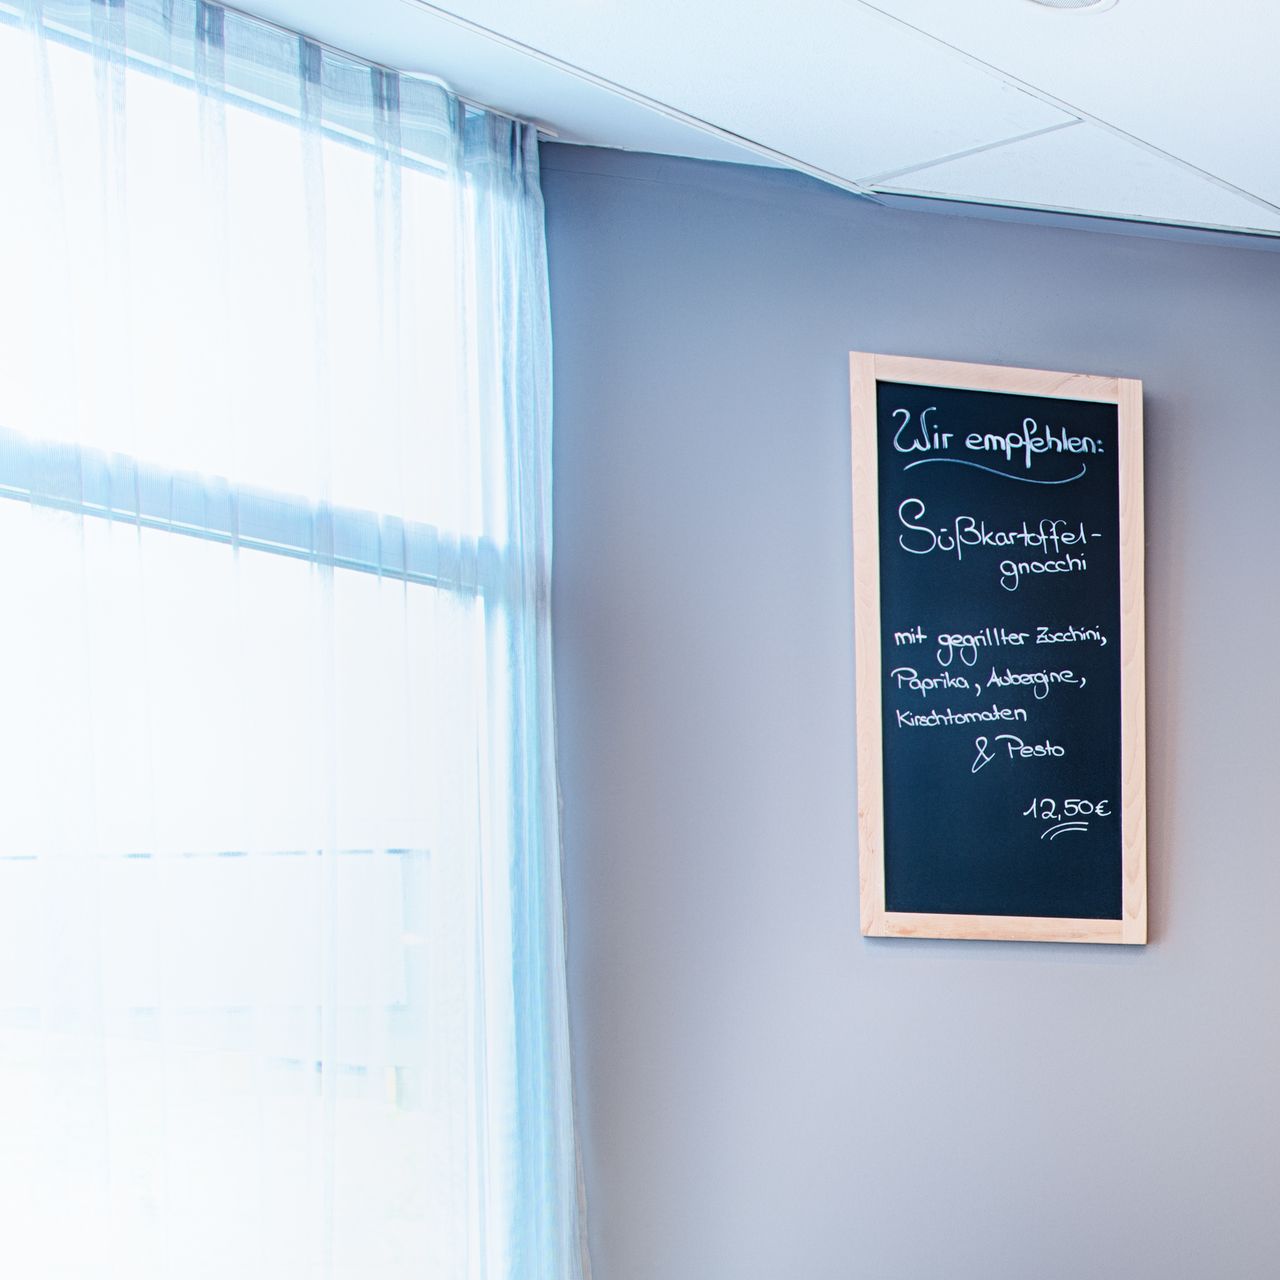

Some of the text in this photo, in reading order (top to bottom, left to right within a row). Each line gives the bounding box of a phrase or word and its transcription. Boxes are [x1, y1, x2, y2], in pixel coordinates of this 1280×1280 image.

[891, 406, 1104, 471] Wir empfehlen:
[898, 498, 1102, 561] Süßkartoffel-
[1000, 556, 1088, 592] gnocchi
[894, 625, 1108, 667] mit gegrillter Zucchini,
[986, 666, 1087, 700] Aubergine,
[896, 704, 1028, 729] Kirschtomaten
[971, 735, 1066, 774] & Pesto
[1022, 798, 1112, 824] 12,50€
